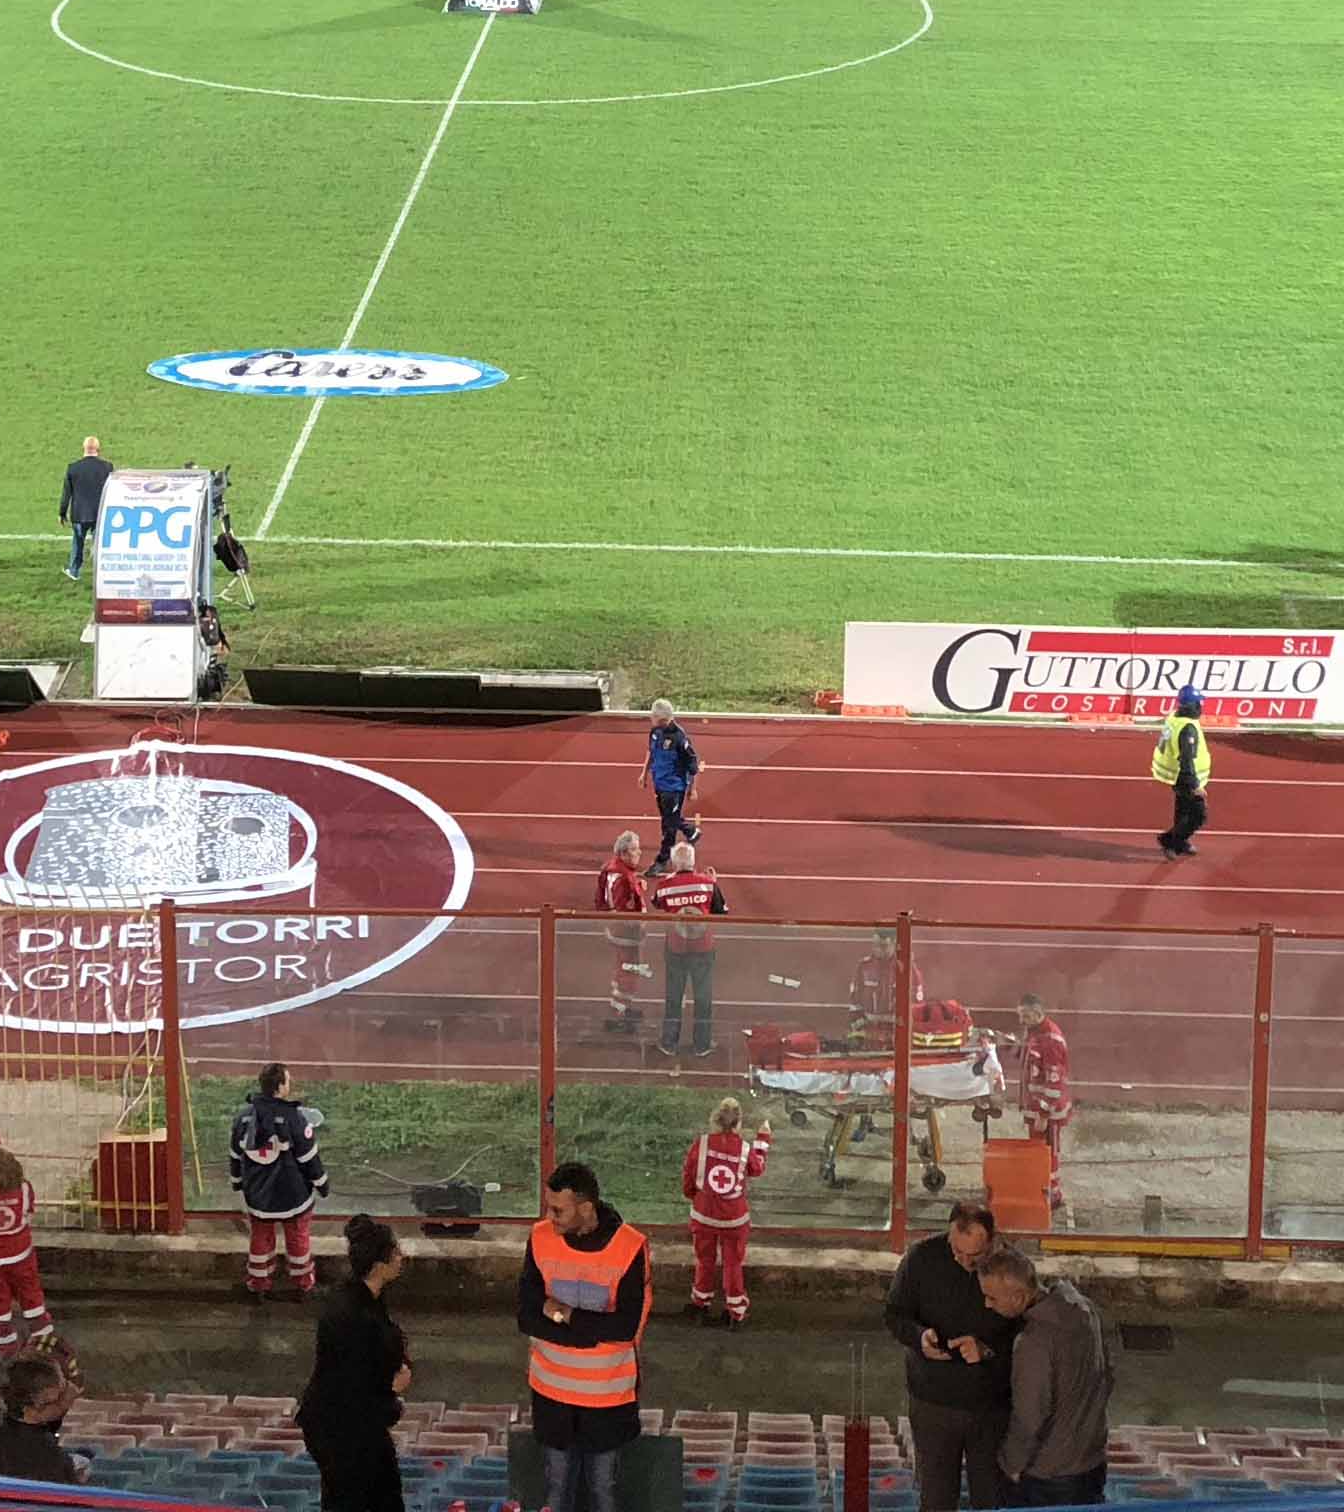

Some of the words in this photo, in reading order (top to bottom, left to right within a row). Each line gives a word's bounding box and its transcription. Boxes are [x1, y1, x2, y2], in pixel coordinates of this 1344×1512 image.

[101, 505, 193, 550] PPG
[1281, 637, 1323, 655] S.r.l.
[1023, 692, 1307, 718] COSTRUIONI
[18, 922, 155, 954] DUE
[175, 914, 370, 946] TORRI
